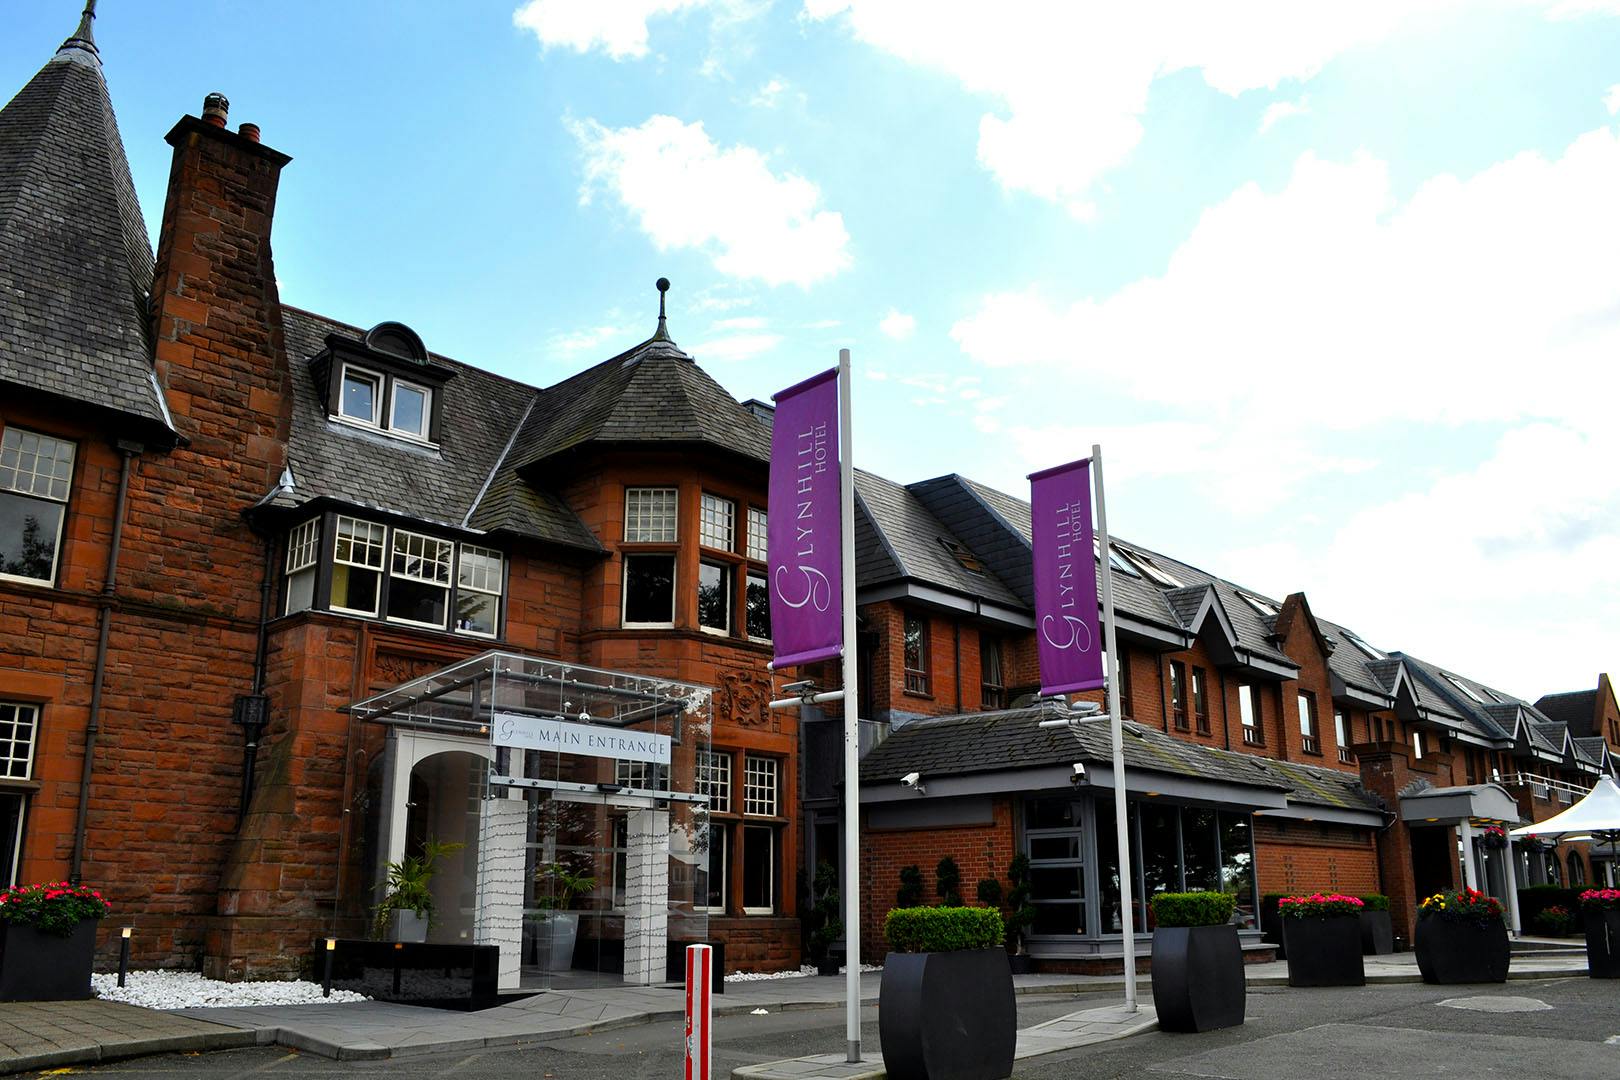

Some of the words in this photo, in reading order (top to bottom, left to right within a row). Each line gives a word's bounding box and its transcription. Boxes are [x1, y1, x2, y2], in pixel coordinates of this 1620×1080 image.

[815, 421, 827, 474] HOTEL
[775, 425, 831, 612] GLYNHILL
[1071, 500, 1082, 542] HOTEL
[1042, 503, 1092, 653] GLYNHILL
[539, 729, 580, 745] MAIN
[588, 735, 665, 755] ENTRANCE
